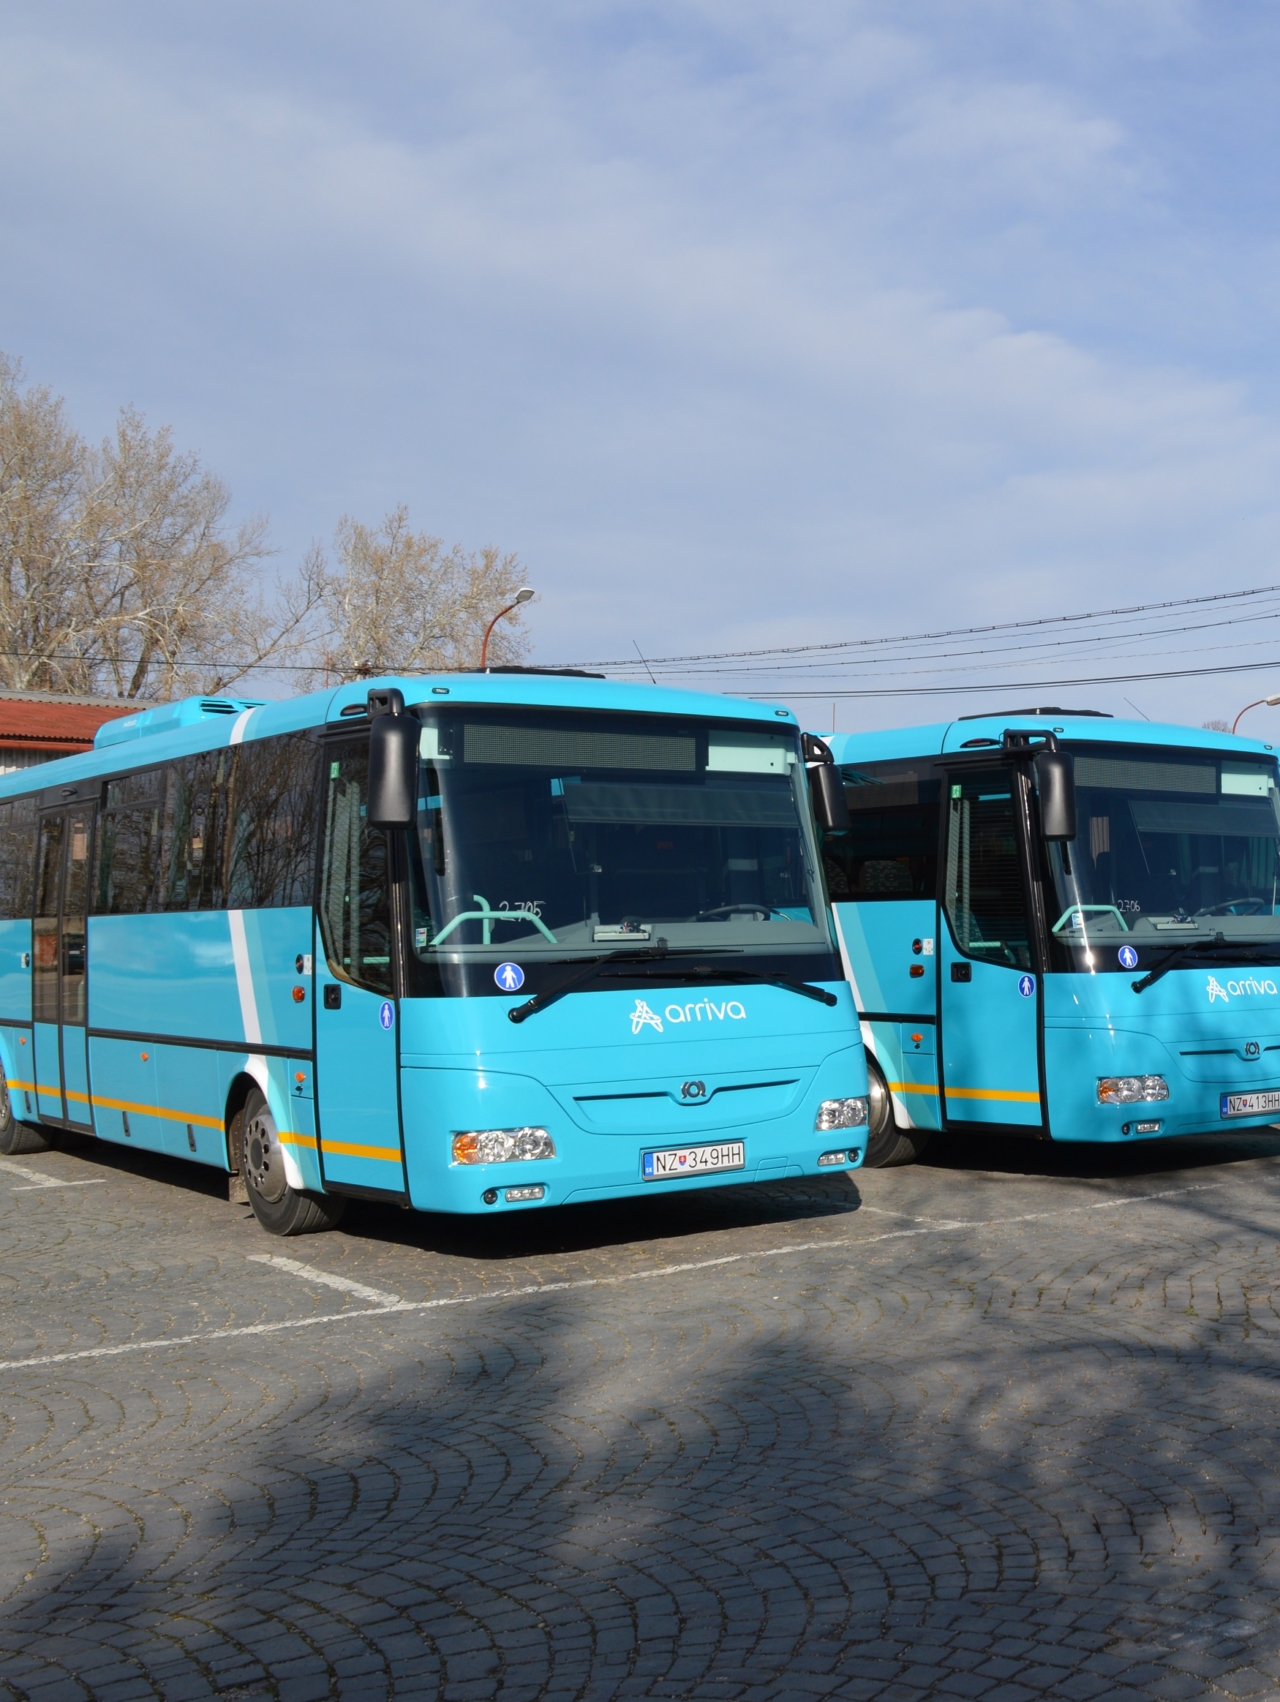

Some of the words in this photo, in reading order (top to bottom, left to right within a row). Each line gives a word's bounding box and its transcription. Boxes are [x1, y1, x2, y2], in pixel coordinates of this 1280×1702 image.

[499, 900, 546, 922] 2705
[1117, 899, 1141, 913] 2706
[1227, 976, 1278, 996] arriva
[664, 997, 747, 1024] arriva
[1229, 1097, 1242, 1113] NZ
[1248, 1093, 1280, 1110] 413HH
[656, 1152, 678, 1173] NZ
[688, 1145, 741, 1169] 349HH
